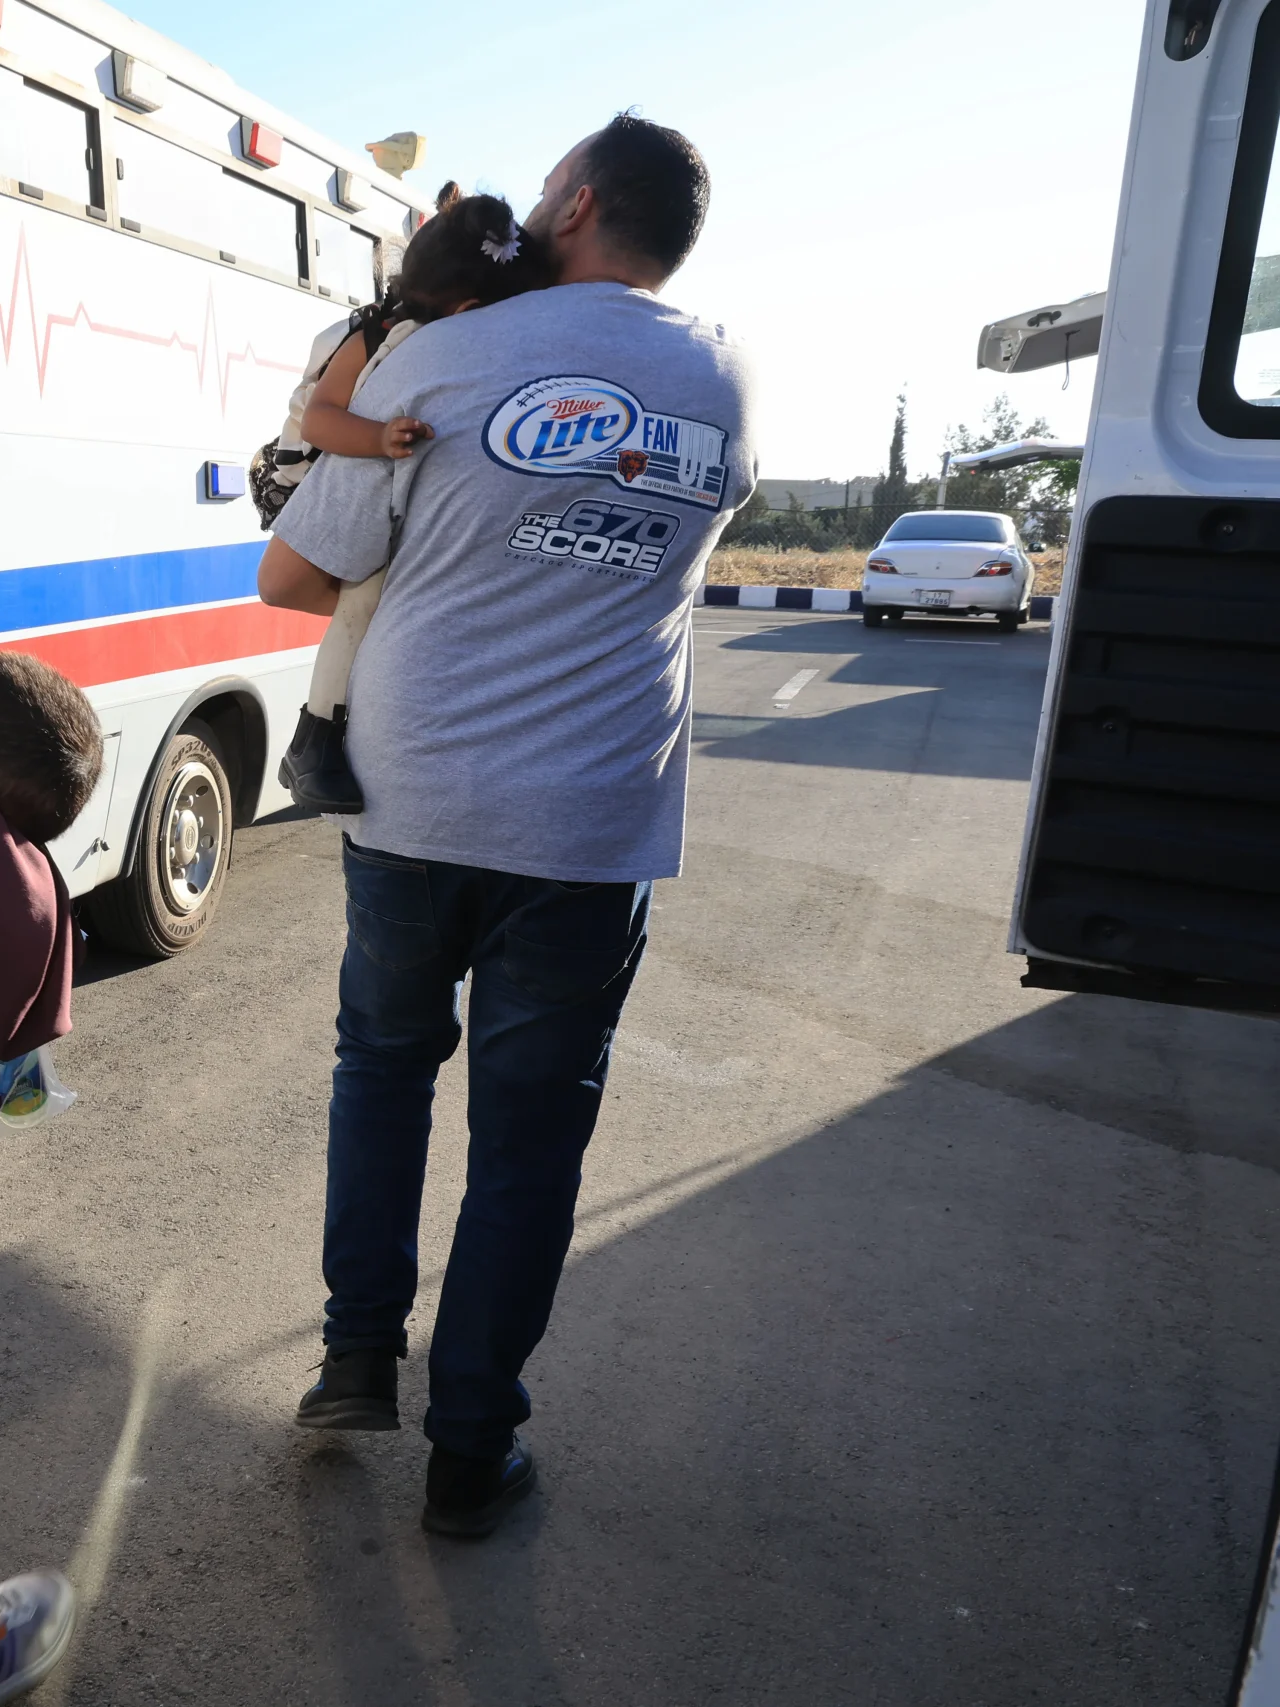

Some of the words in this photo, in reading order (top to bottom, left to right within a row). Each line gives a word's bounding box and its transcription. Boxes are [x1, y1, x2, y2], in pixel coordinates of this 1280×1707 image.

[547, 399, 605, 416] Miller
[527, 412, 620, 460] Lite
[642, 416, 679, 454] FAN
[677, 422, 720, 490] UP
[523, 514, 562, 528] THE
[561, 501, 680, 546] 670
[504, 552, 564, 567] CHICAGO
[509, 524, 665, 573] SCORE
[166, 911, 207, 936] DUNLOP
